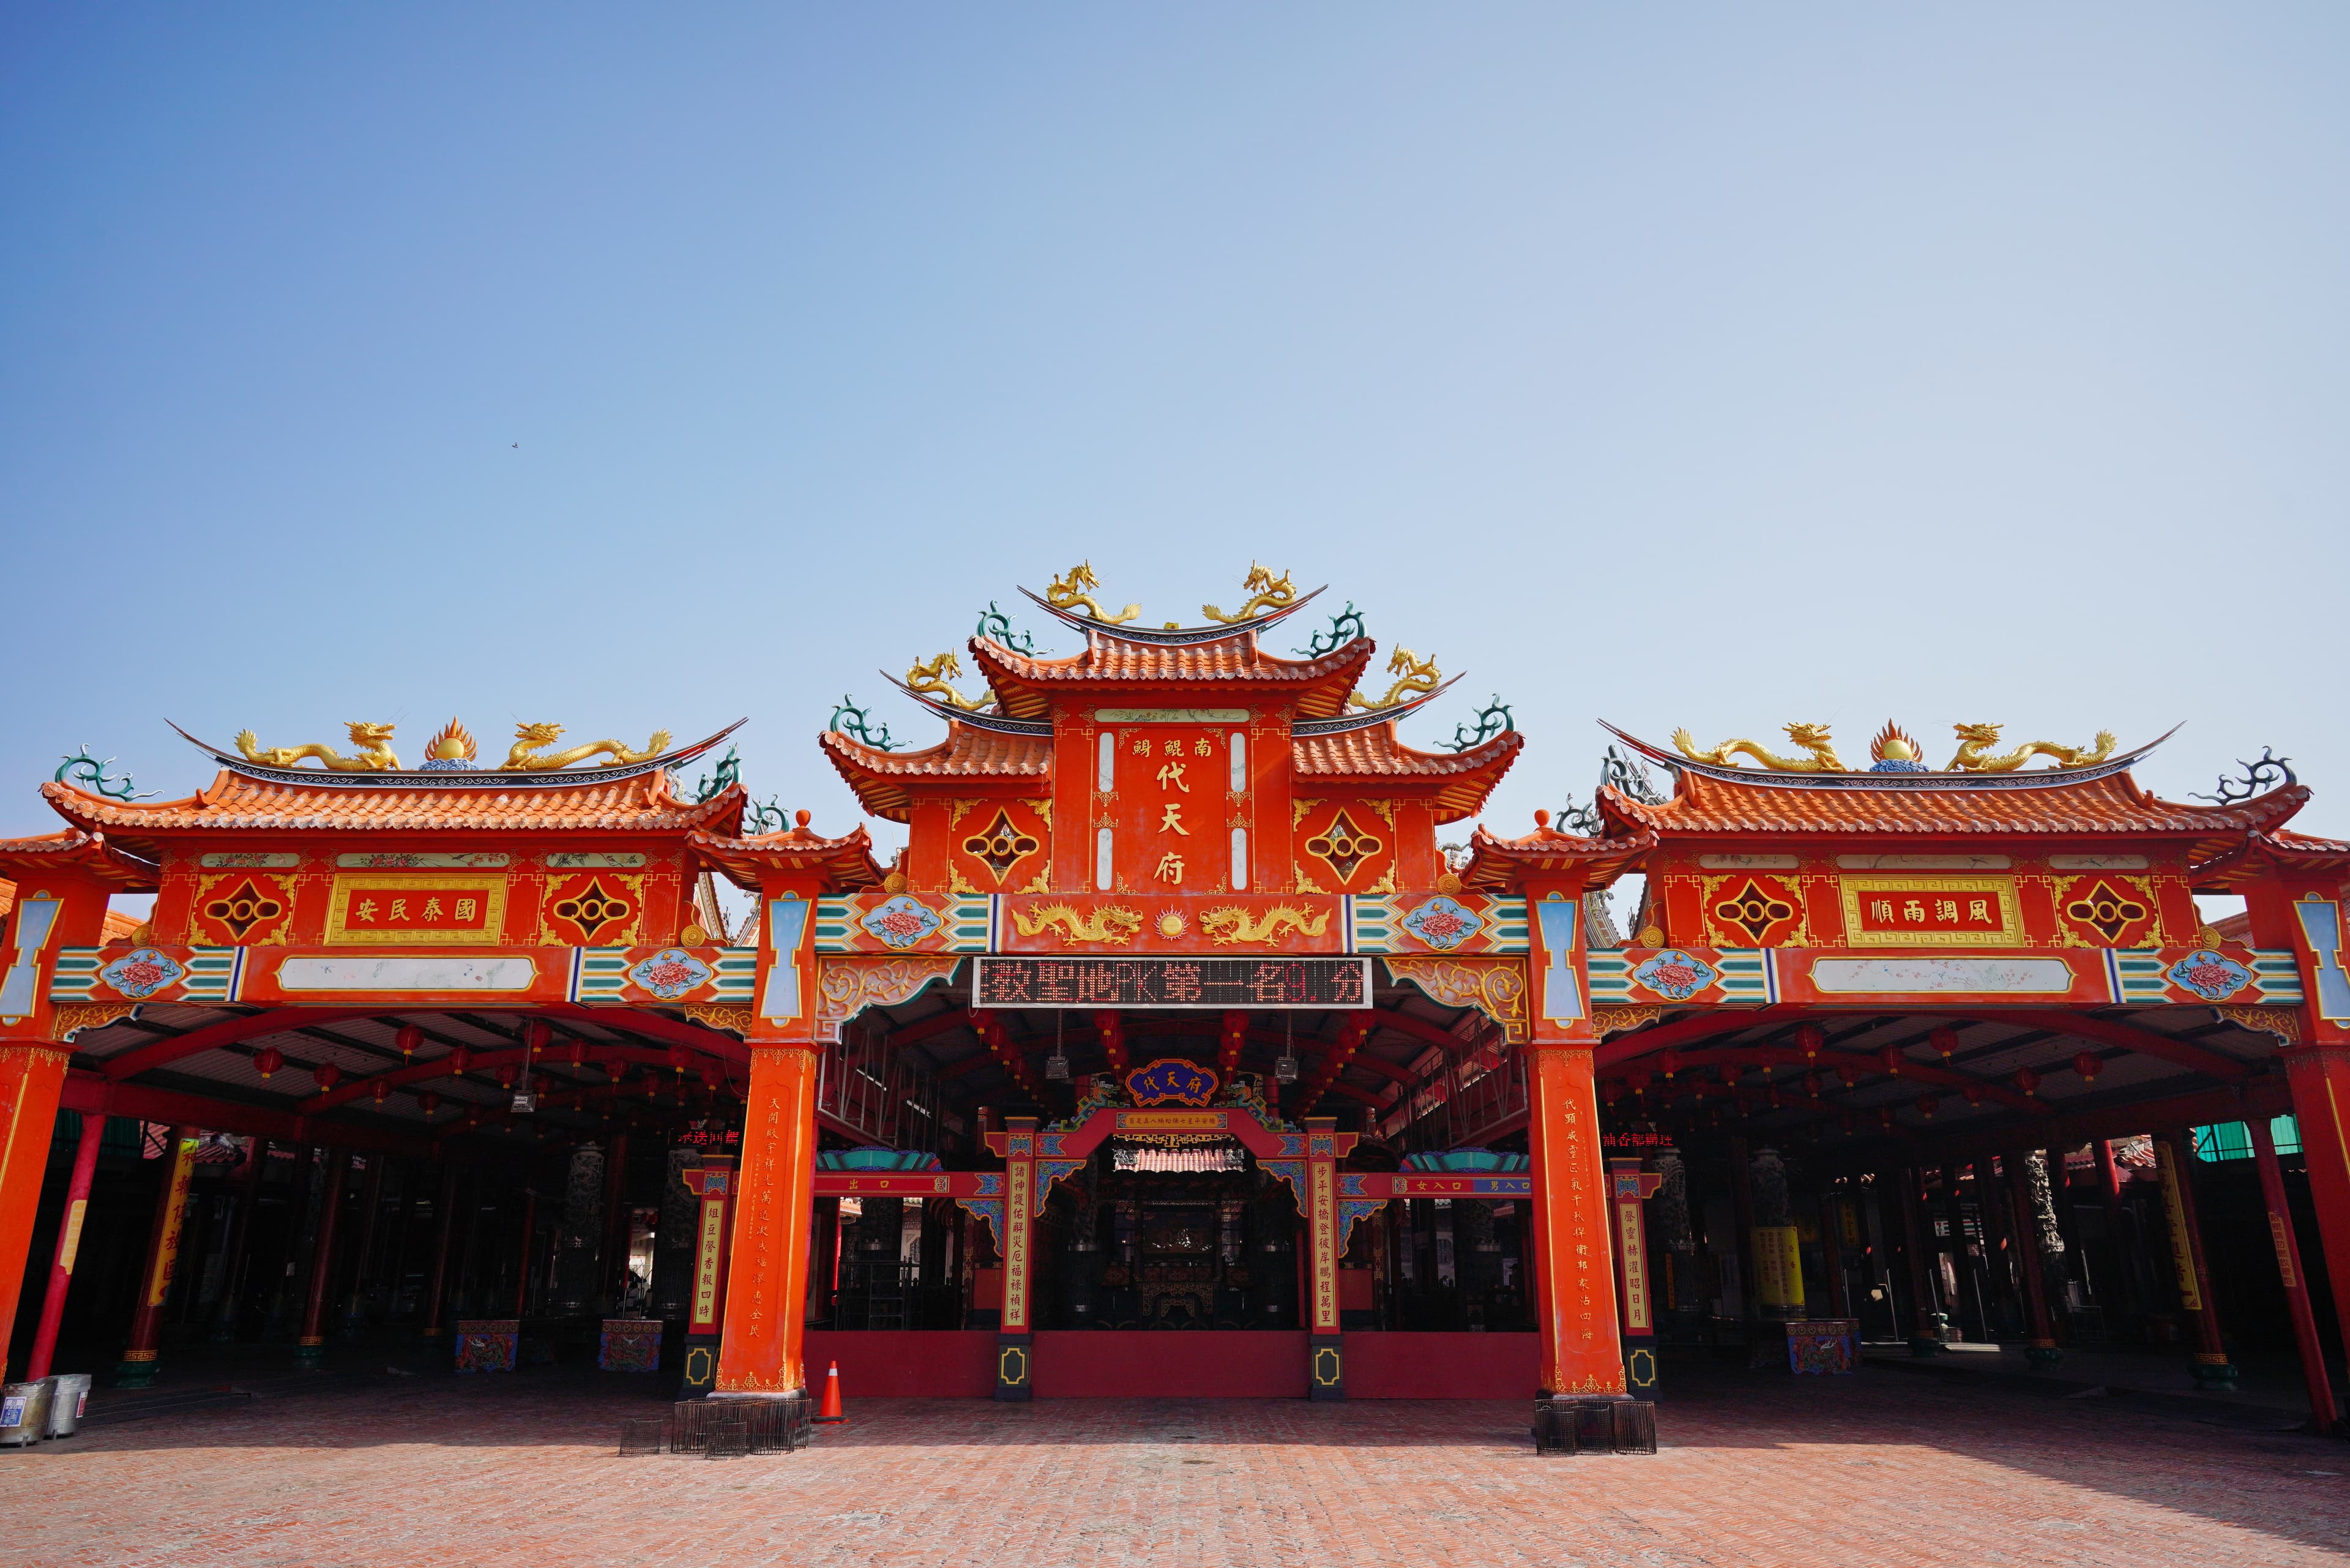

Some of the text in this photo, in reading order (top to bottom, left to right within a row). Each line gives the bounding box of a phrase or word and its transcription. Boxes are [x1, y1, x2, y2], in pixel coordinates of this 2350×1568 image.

[1132, 737, 1212, 758] 南鯤鯓
[1153, 761, 1190, 885] 代天府
[355, 897, 477, 922] 國泰民安
[1871, 898, 1993, 924] 風調雨順
[1144, 1071, 1202, 1093] 代天府
[849, 1178, 890, 1190] 出口
[1416, 1180, 1462, 1191] 女入口
[1490, 1180, 1530, 1191] 男入口
[1317, 1165, 1332, 1323] 步平安橋登彼岸鵬程萬里
